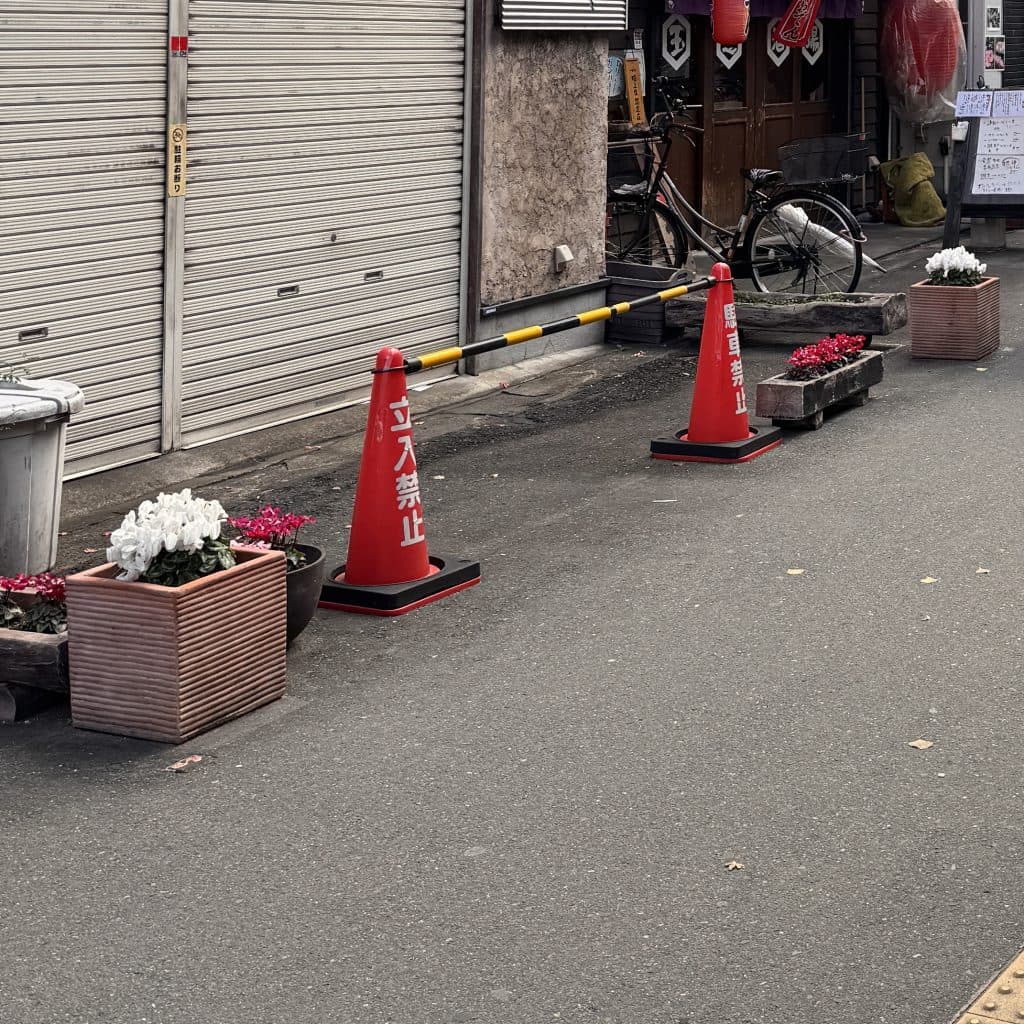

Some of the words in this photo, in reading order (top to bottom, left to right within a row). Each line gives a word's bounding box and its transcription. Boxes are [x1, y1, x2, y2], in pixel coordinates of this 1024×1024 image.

[724, 303, 748, 414] 駐車禁止
[389, 396, 425, 547] 立入禁止
